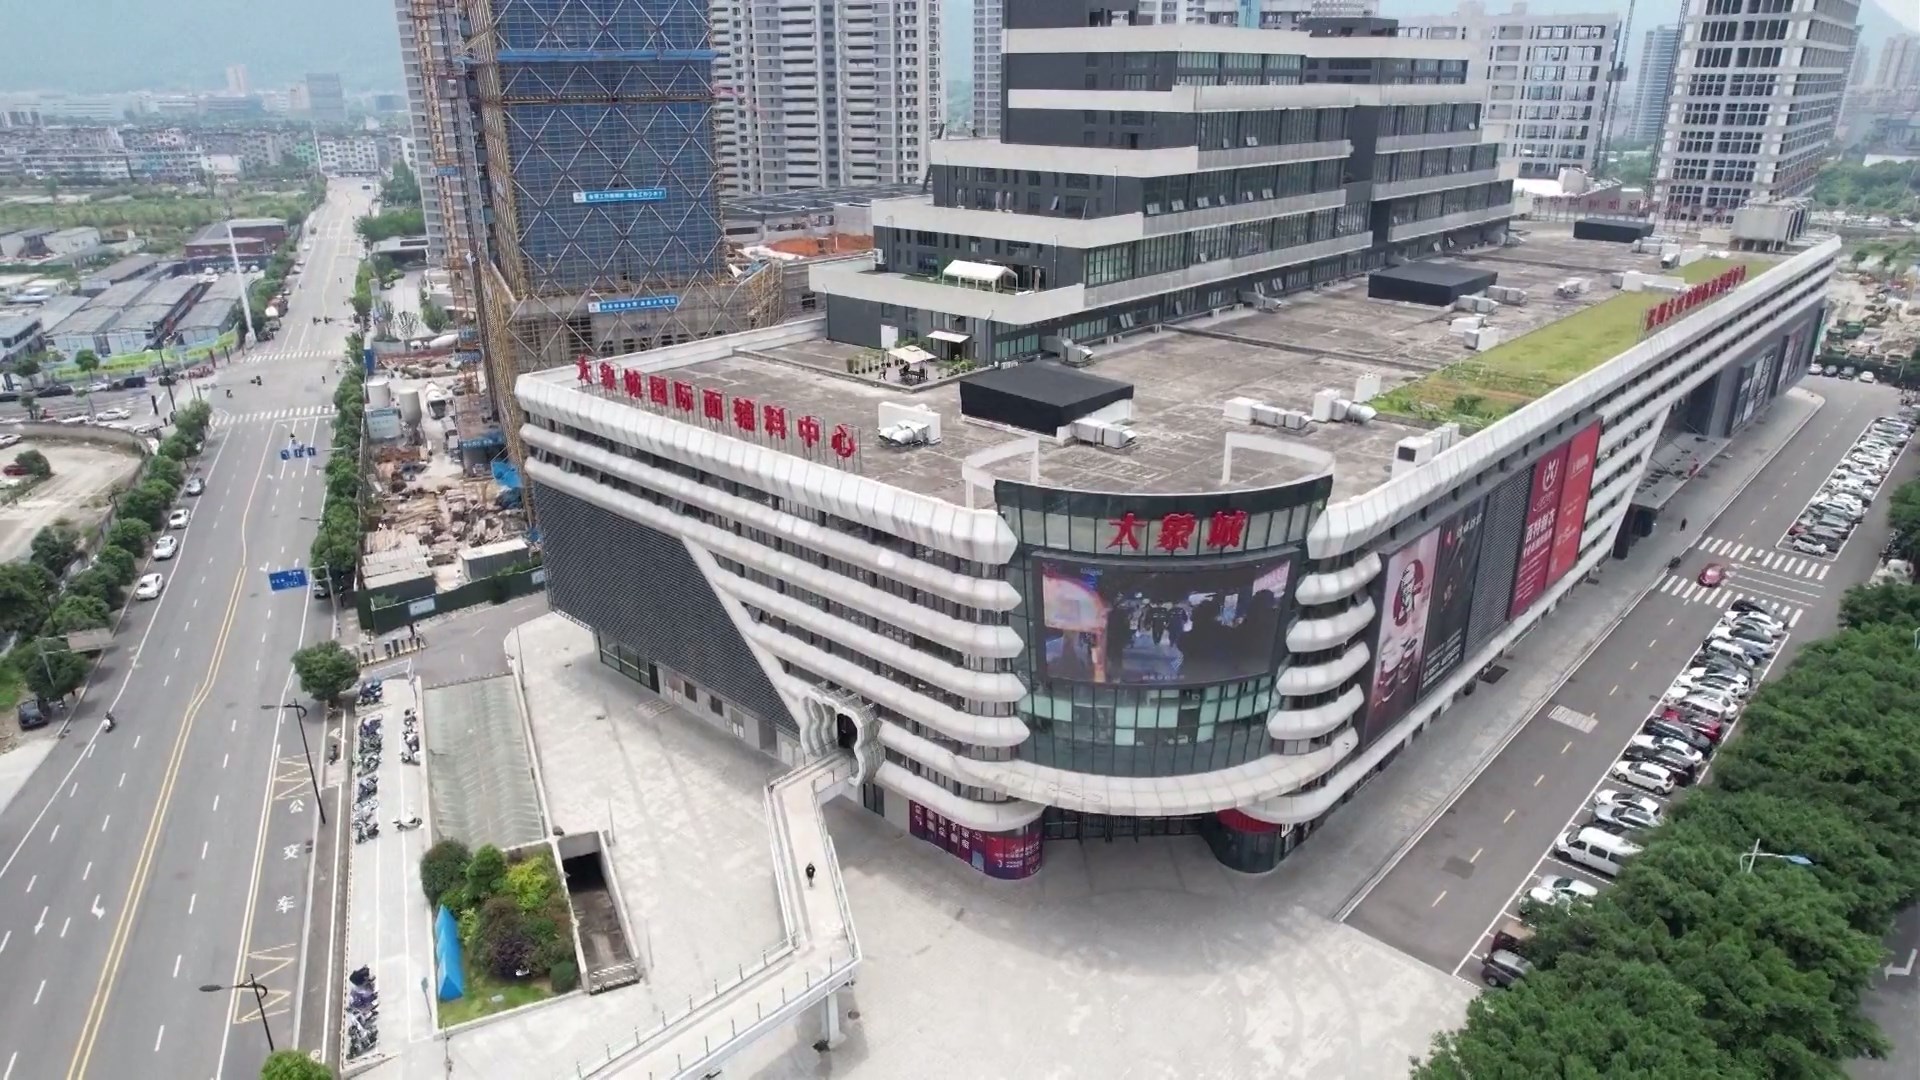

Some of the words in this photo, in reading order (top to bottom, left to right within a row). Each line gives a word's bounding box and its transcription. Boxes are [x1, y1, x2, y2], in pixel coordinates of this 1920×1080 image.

[1106, 510, 1246, 551] 大象城
[276, 799, 304, 914] 公交车
